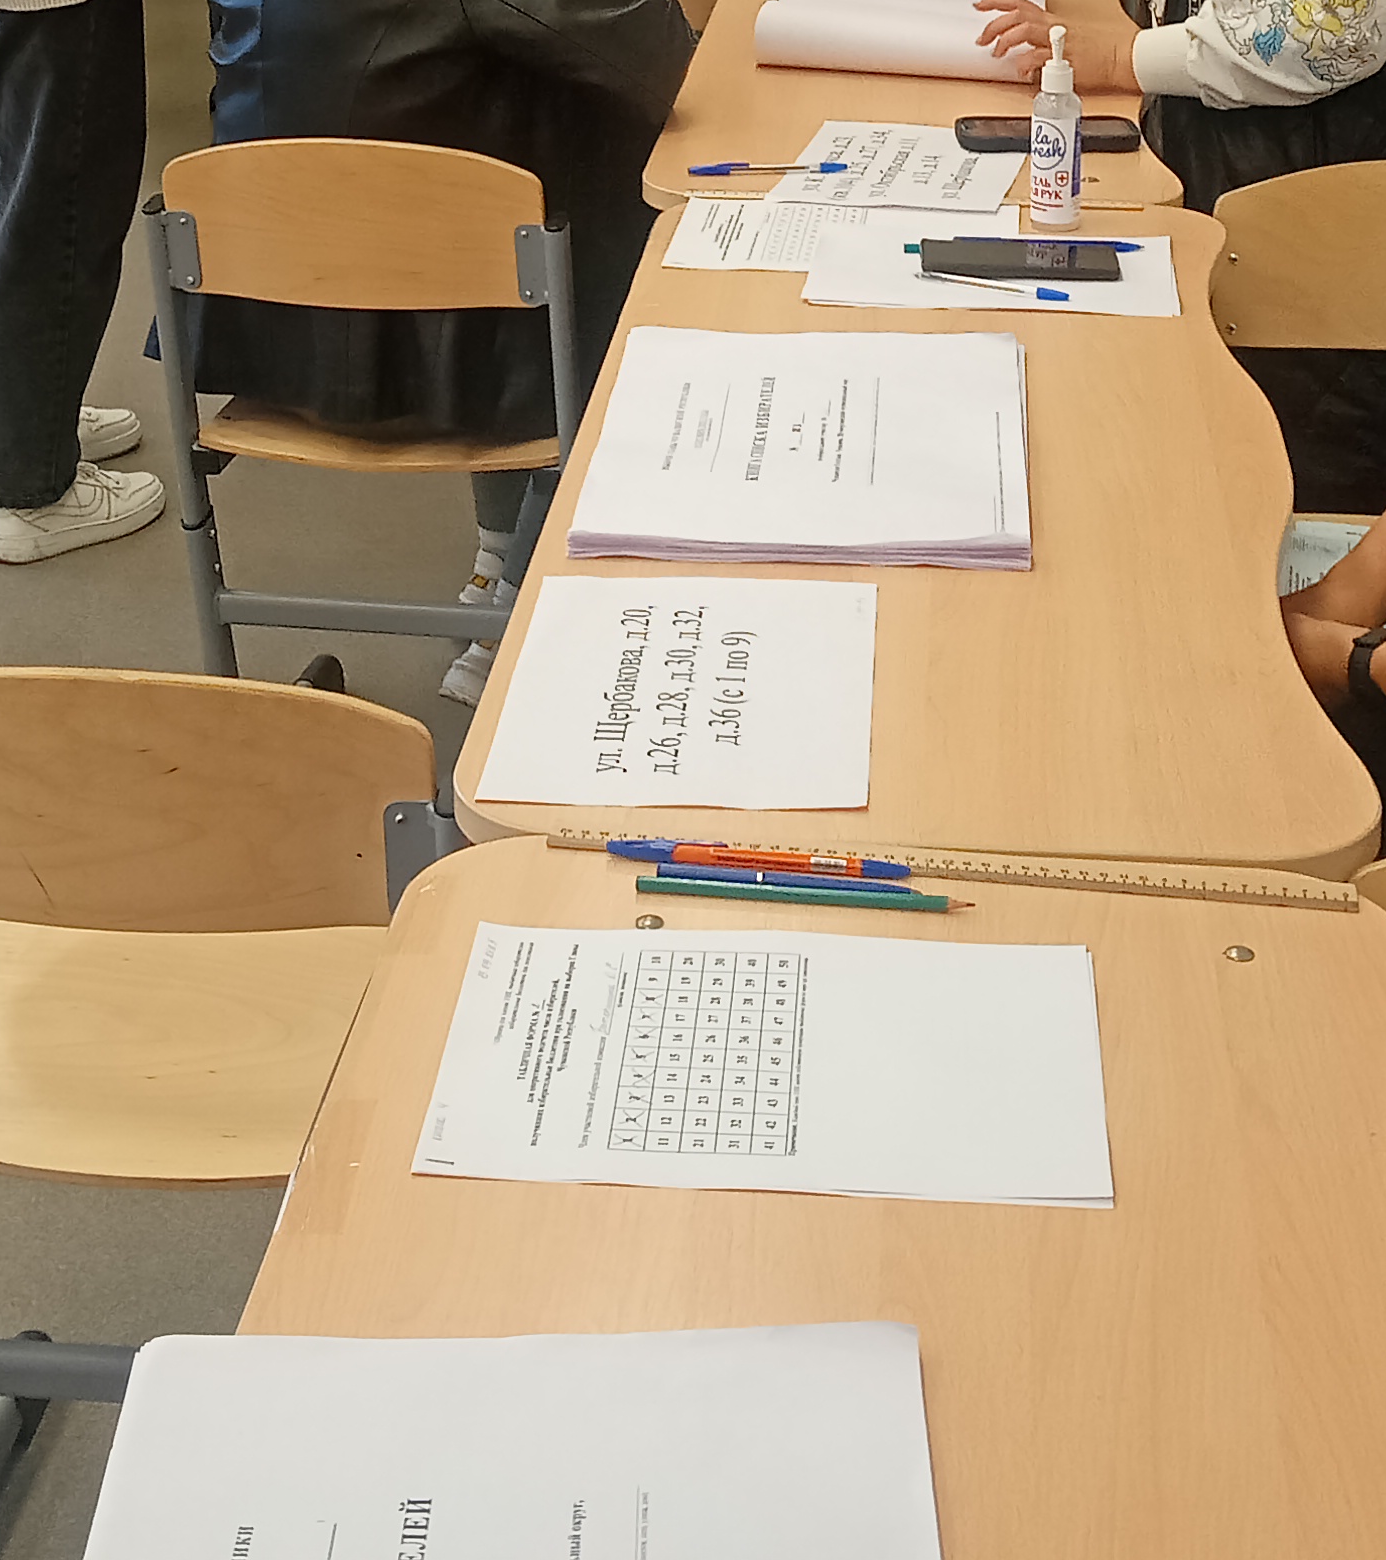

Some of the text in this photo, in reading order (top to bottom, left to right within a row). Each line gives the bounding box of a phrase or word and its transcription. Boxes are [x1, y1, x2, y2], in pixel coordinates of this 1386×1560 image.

[720, 631, 760, 646] 9)
[726, 650, 750, 670] по
[594, 605, 658, 773] ул. Щербакова, д.20,
[646, 606, 710, 775] д.26, д.28, д.30, д.32,
[708, 708, 742, 746] д.36
[712, 978, 723, 986] 29
[744, 979, 755, 988] 39
[675, 1013, 685, 1022] 17
[707, 1014, 718, 1023] 27
[740, 1015, 751, 1024] 37
[773, 1016, 783, 1026] 47
[705, 1034, 716, 1043] 26
[738, 1036, 750, 1044] 36
[669, 1053, 680, 1062] 15
[702, 1054, 714, 1063] 25
[736, 1055, 748, 1064] 35
[770, 1056, 781, 1066] 45
[666, 1073, 678, 1082] 14
[700, 1074, 712, 1084] 24
[734, 1076, 746, 1085] 34
[769, 1078, 779, 1086] 44
[663, 1094, 675, 1103] 13
[697, 1096, 709, 1105] 23
[732, 1097, 744, 1107] 33
[767, 1099, 778, 1108] 43
[660, 1116, 672, 1125] 12
[694, 1118, 707, 1127] 22
[730, 1119, 742, 1128] 32
[765, 1121, 777, 1130] 42
[657, 1138, 669, 1146] 11
[692, 1139, 704, 1148] 21
[728, 1140, 740, 1149] 31
[764, 1141, 775, 1150] 41
